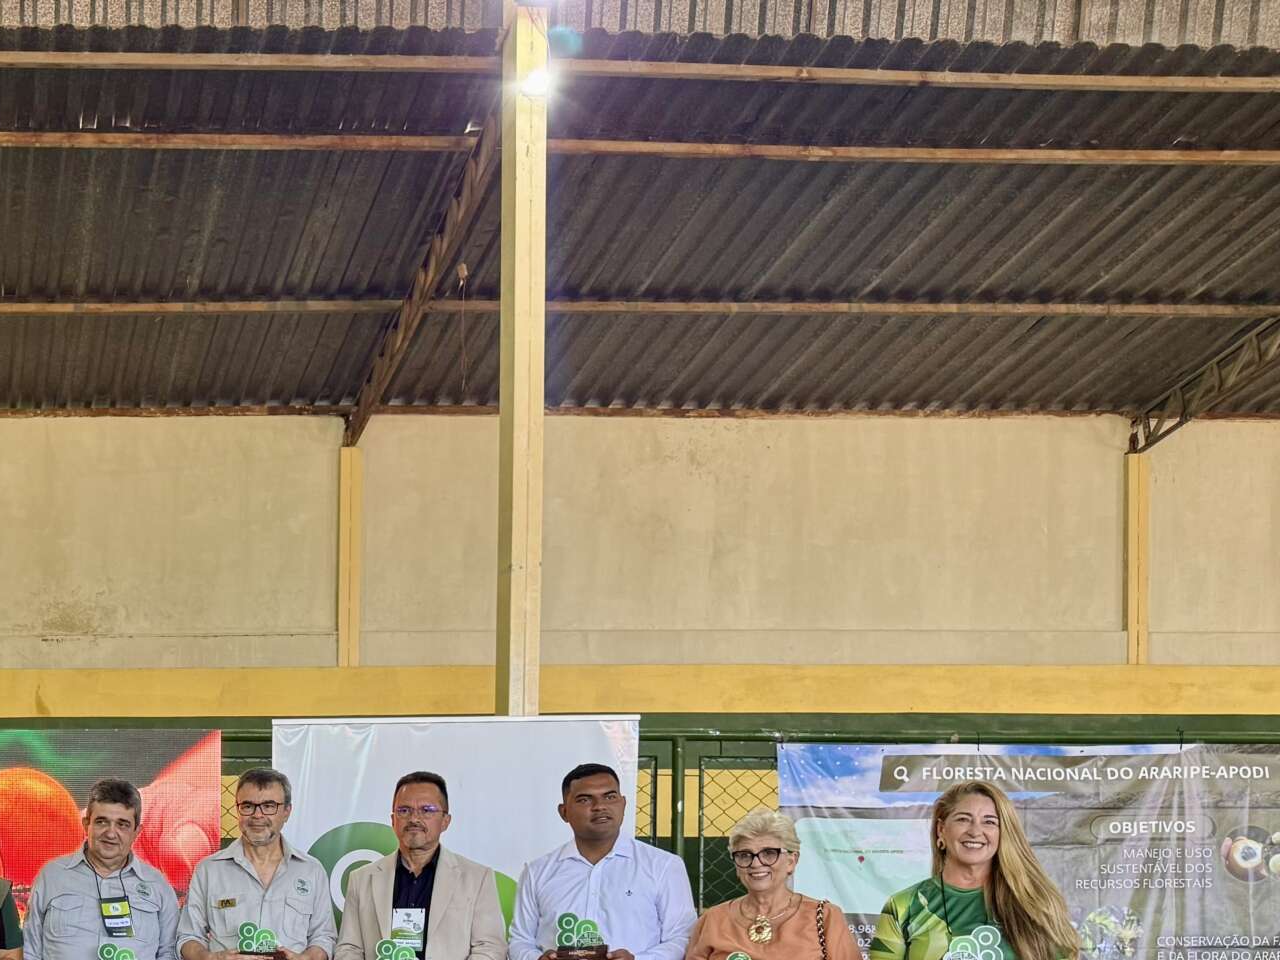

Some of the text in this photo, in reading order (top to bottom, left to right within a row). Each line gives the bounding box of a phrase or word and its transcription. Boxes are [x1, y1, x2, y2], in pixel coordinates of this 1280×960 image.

[922, 766, 1270, 781] FLORESTA NACIONAL DO ARARIPE-APODI
[1109, 821, 1196, 836] OBJETIVOS
[1124, 848, 1213, 860] MANEJO E USO
[1100, 859, 1213, 874] SUSTENTÁVEL DOS
[1075, 878, 1213, 889] RECURSOS FLORESTAIS
[1157, 934, 1250, 949] CONSERVAÇÃO
[1253, 936, 1270, 946] DA
[1158, 951, 1164, 960] E
[1170, 951, 1185, 960] DA
[1188, 951, 1227, 960] FLORA
[1232, 951, 1251, 960] DO
